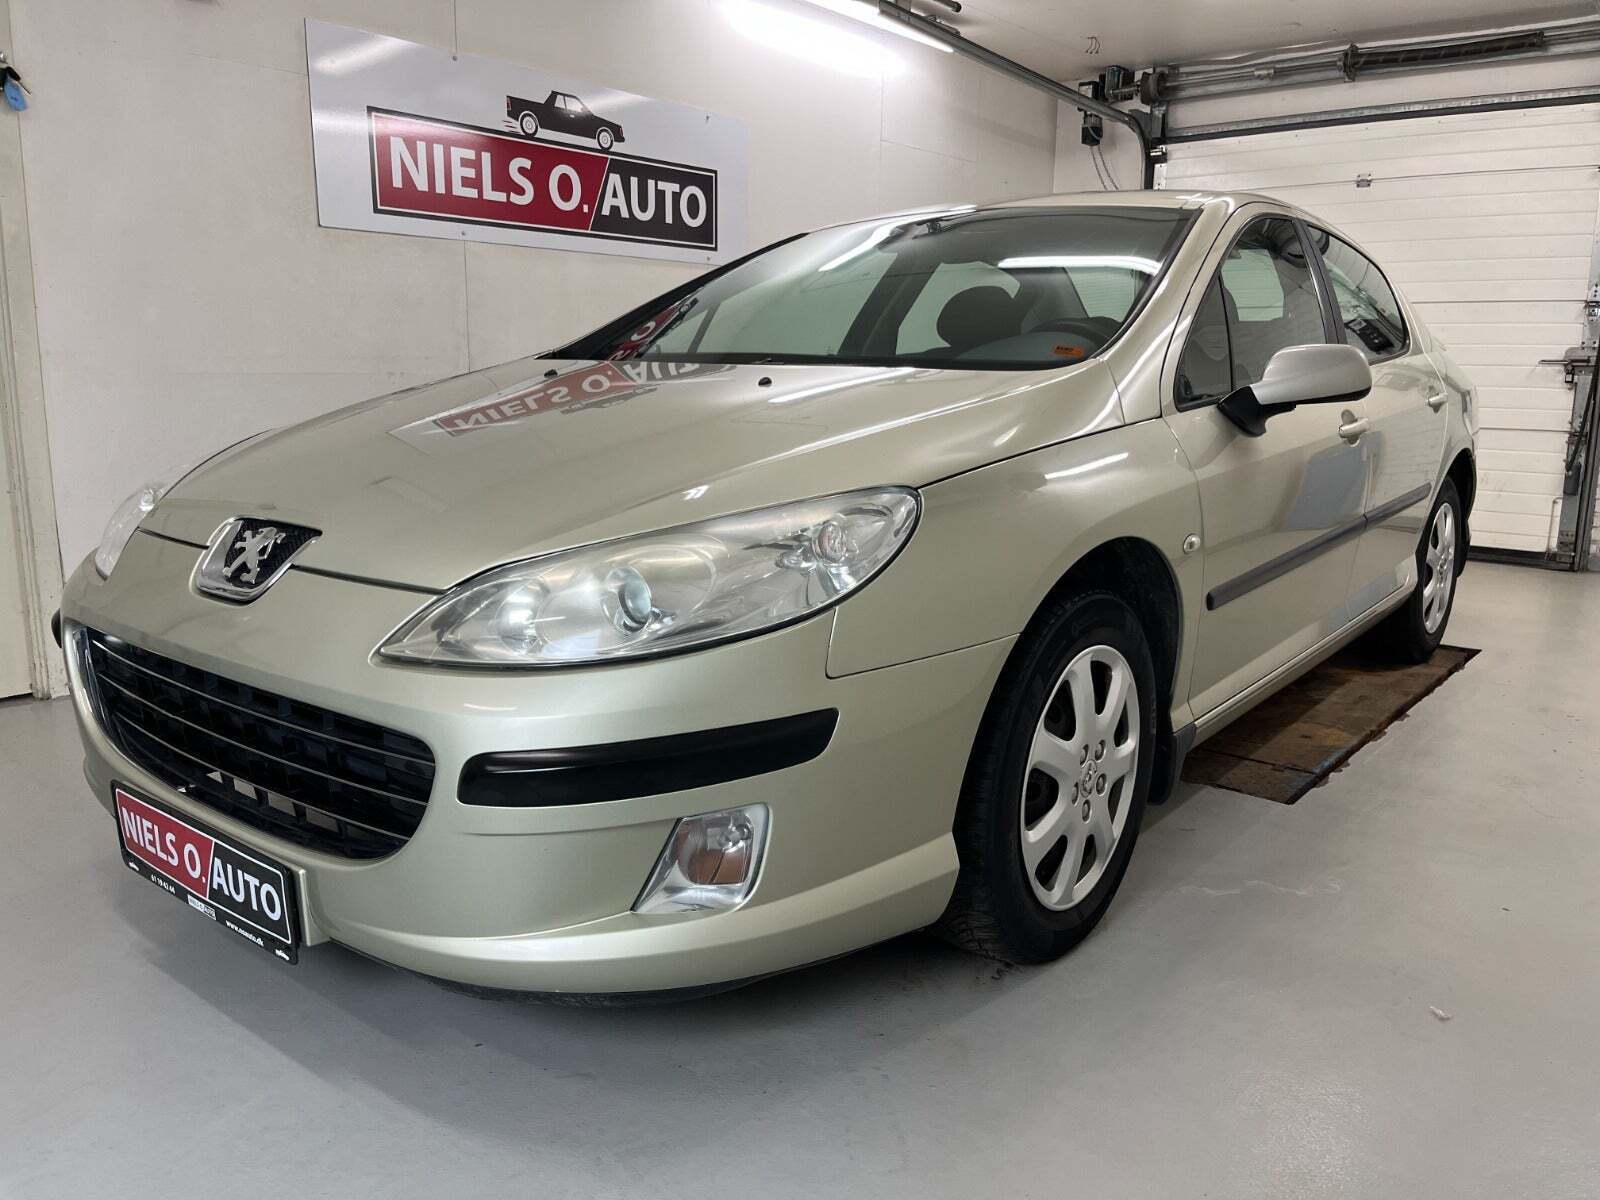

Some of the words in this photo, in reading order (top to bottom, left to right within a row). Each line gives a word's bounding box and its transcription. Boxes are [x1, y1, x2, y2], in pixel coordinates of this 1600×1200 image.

[390, 136, 535, 205] NIELS
[549, 164, 589, 213] O.
[602, 172, 707, 228] AUTO
[122, 807, 179, 867] NIELS
[183, 843, 206, 884] O.
[212, 857, 282, 921] AUTO
